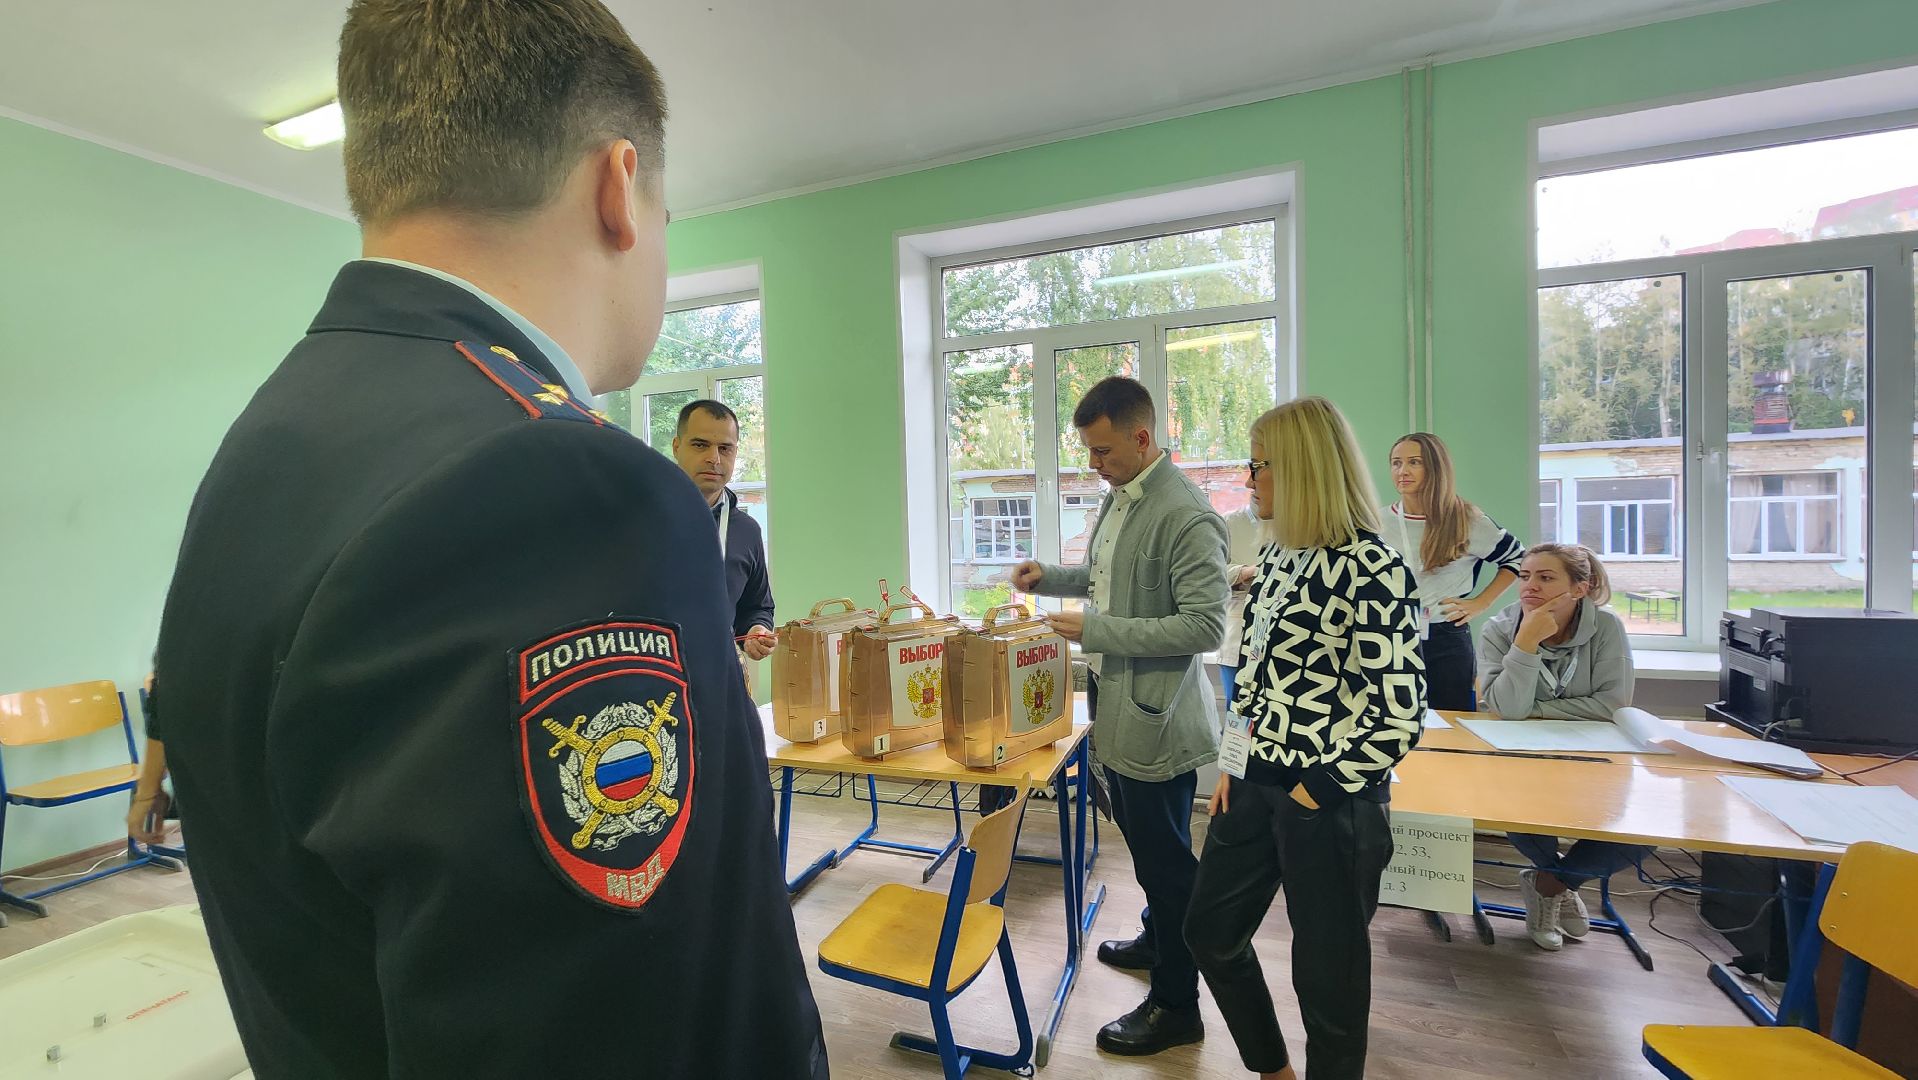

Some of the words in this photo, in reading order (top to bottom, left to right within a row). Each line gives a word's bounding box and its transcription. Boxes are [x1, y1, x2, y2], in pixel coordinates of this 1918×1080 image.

[531, 631, 672, 683] ПОЛИЦИЯ
[899, 642, 944, 665] ВЫБОР
[1016, 643, 1059, 669] ВЫБОРЫ
[816, 720, 823, 735] 3
[878, 737, 885, 751] 1
[996, 745, 1004, 761] 2
[1408, 828, 1470, 843] проспект
[1410, 845, 1431, 859] 53,
[606, 853, 664, 902] МВД
[1420, 868, 1467, 883] проезд
[1399, 881, 1407, 892] 3
